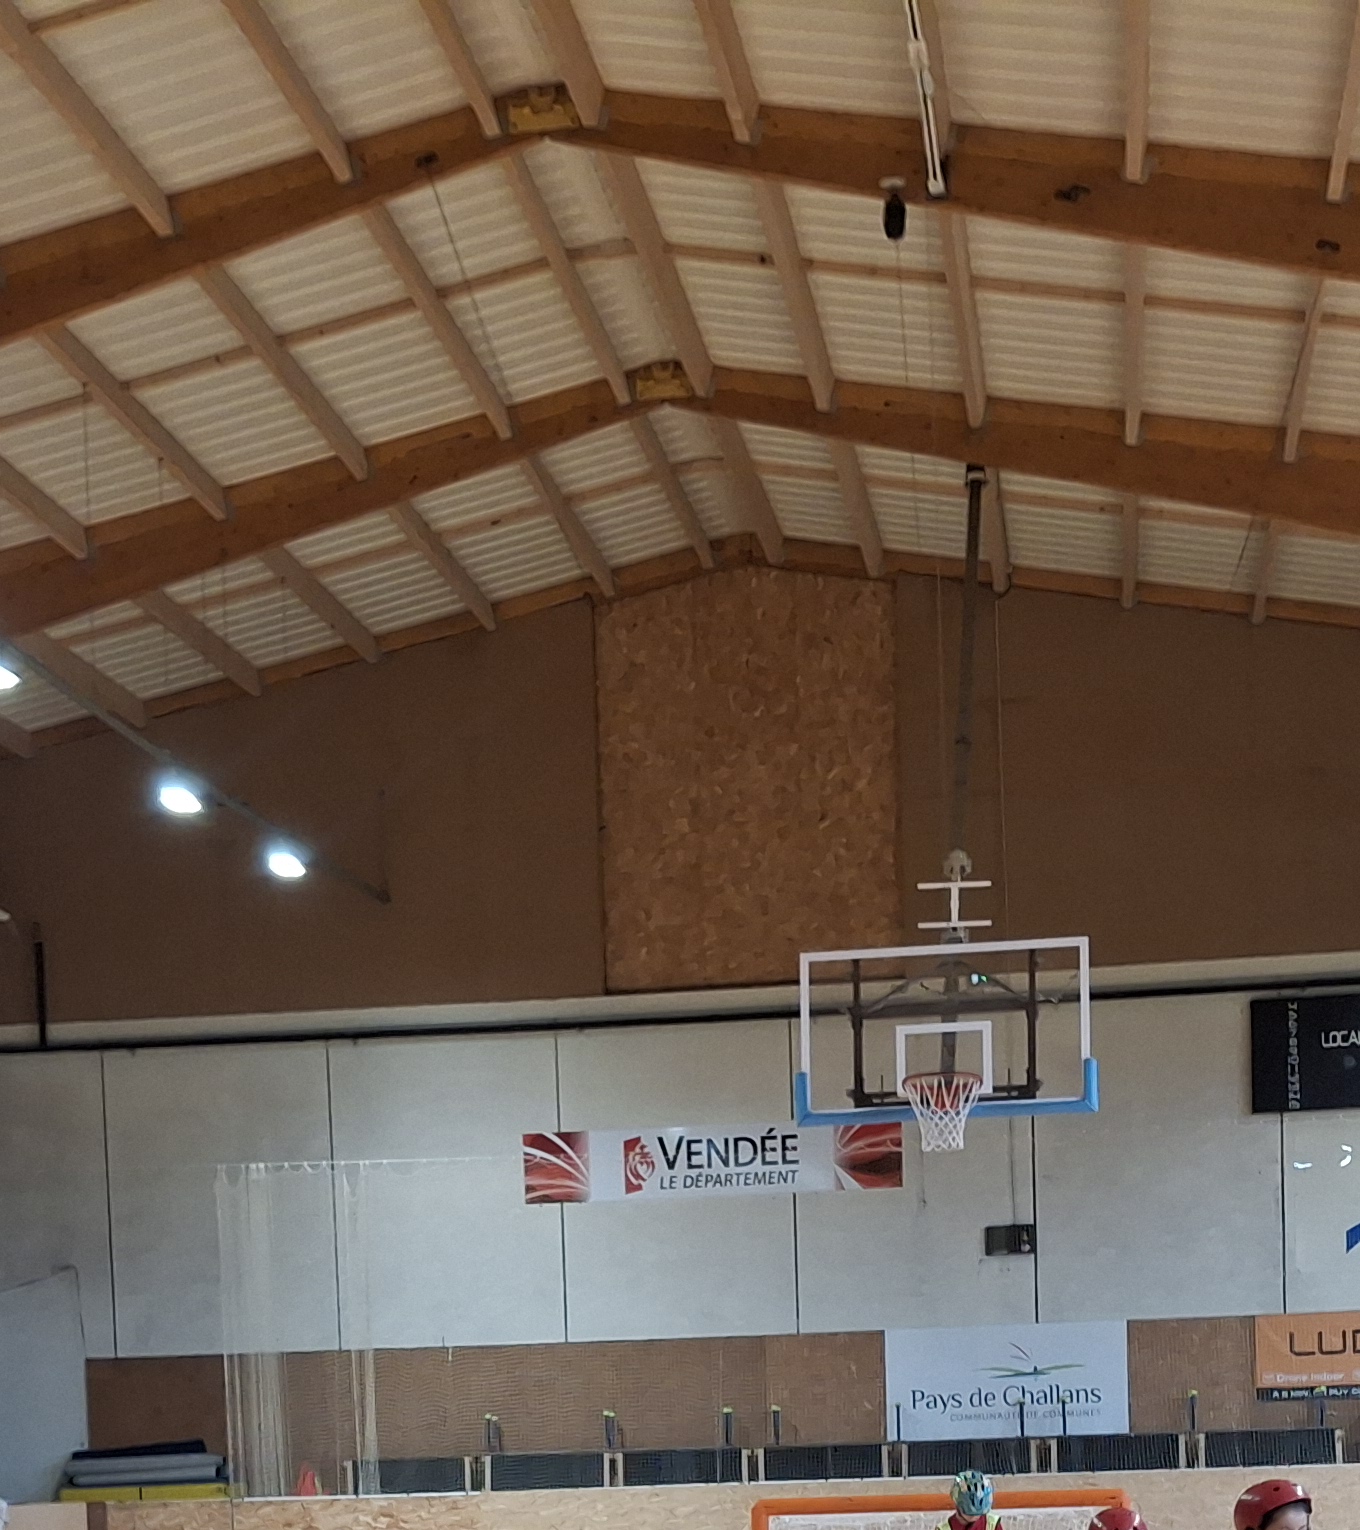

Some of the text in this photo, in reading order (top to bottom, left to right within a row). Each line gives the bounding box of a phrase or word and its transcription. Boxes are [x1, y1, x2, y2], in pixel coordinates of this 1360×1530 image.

[657, 1128, 800, 1170] VENDÉE
[659, 1170, 800, 1190] LE DÉPARTEMENT
[911, 1384, 1102, 1414] Pays de Challans
